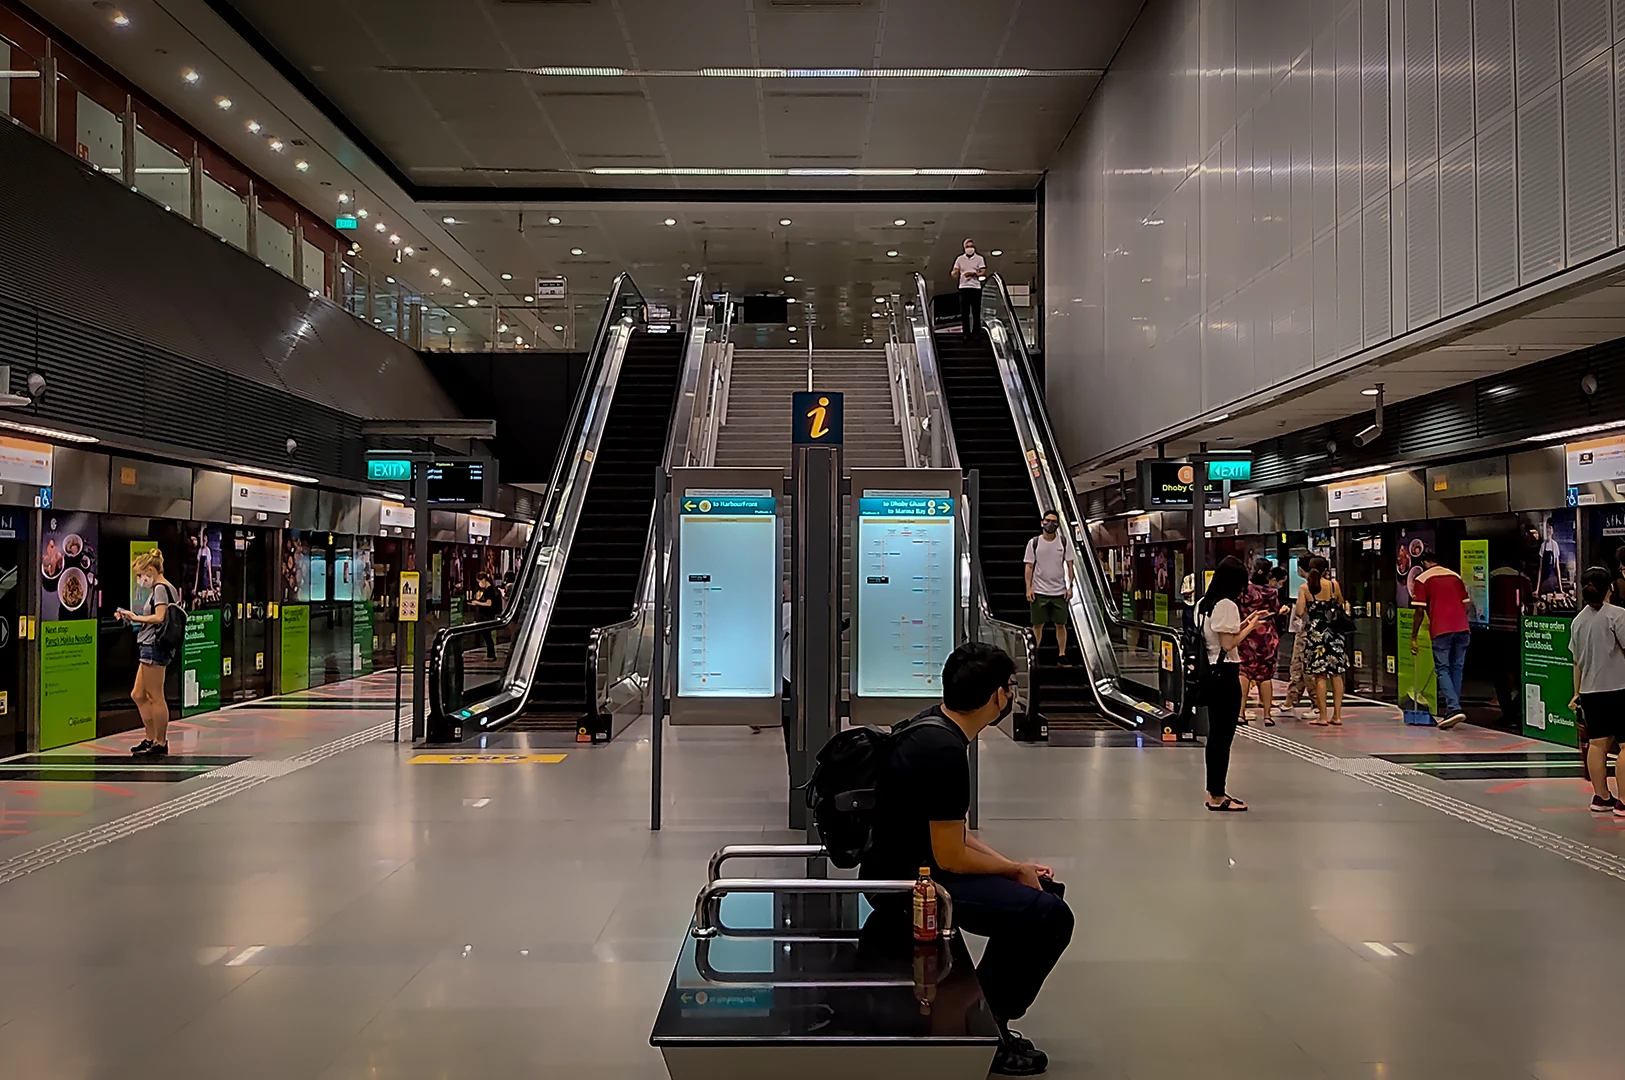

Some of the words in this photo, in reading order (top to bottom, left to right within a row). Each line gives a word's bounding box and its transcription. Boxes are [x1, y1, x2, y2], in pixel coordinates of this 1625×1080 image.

[374, 463, 398, 477] EXIT
[1221, 466, 1245, 477] EXIT
[1162, 484, 1187, 493] Dhoby
[1524, 619, 1533, 628] Get
[1539, 621, 1549, 629] new
[1549, 621, 1565, 630] orders
[45, 626, 57, 634] Next
[1524, 630, 1541, 640] quicker
[1541, 631, 1552, 640] with
[60, 635, 74, 643] Hakka
[75, 633, 93, 643] Noodles
[1553, 717, 1575, 727] quickbooks
